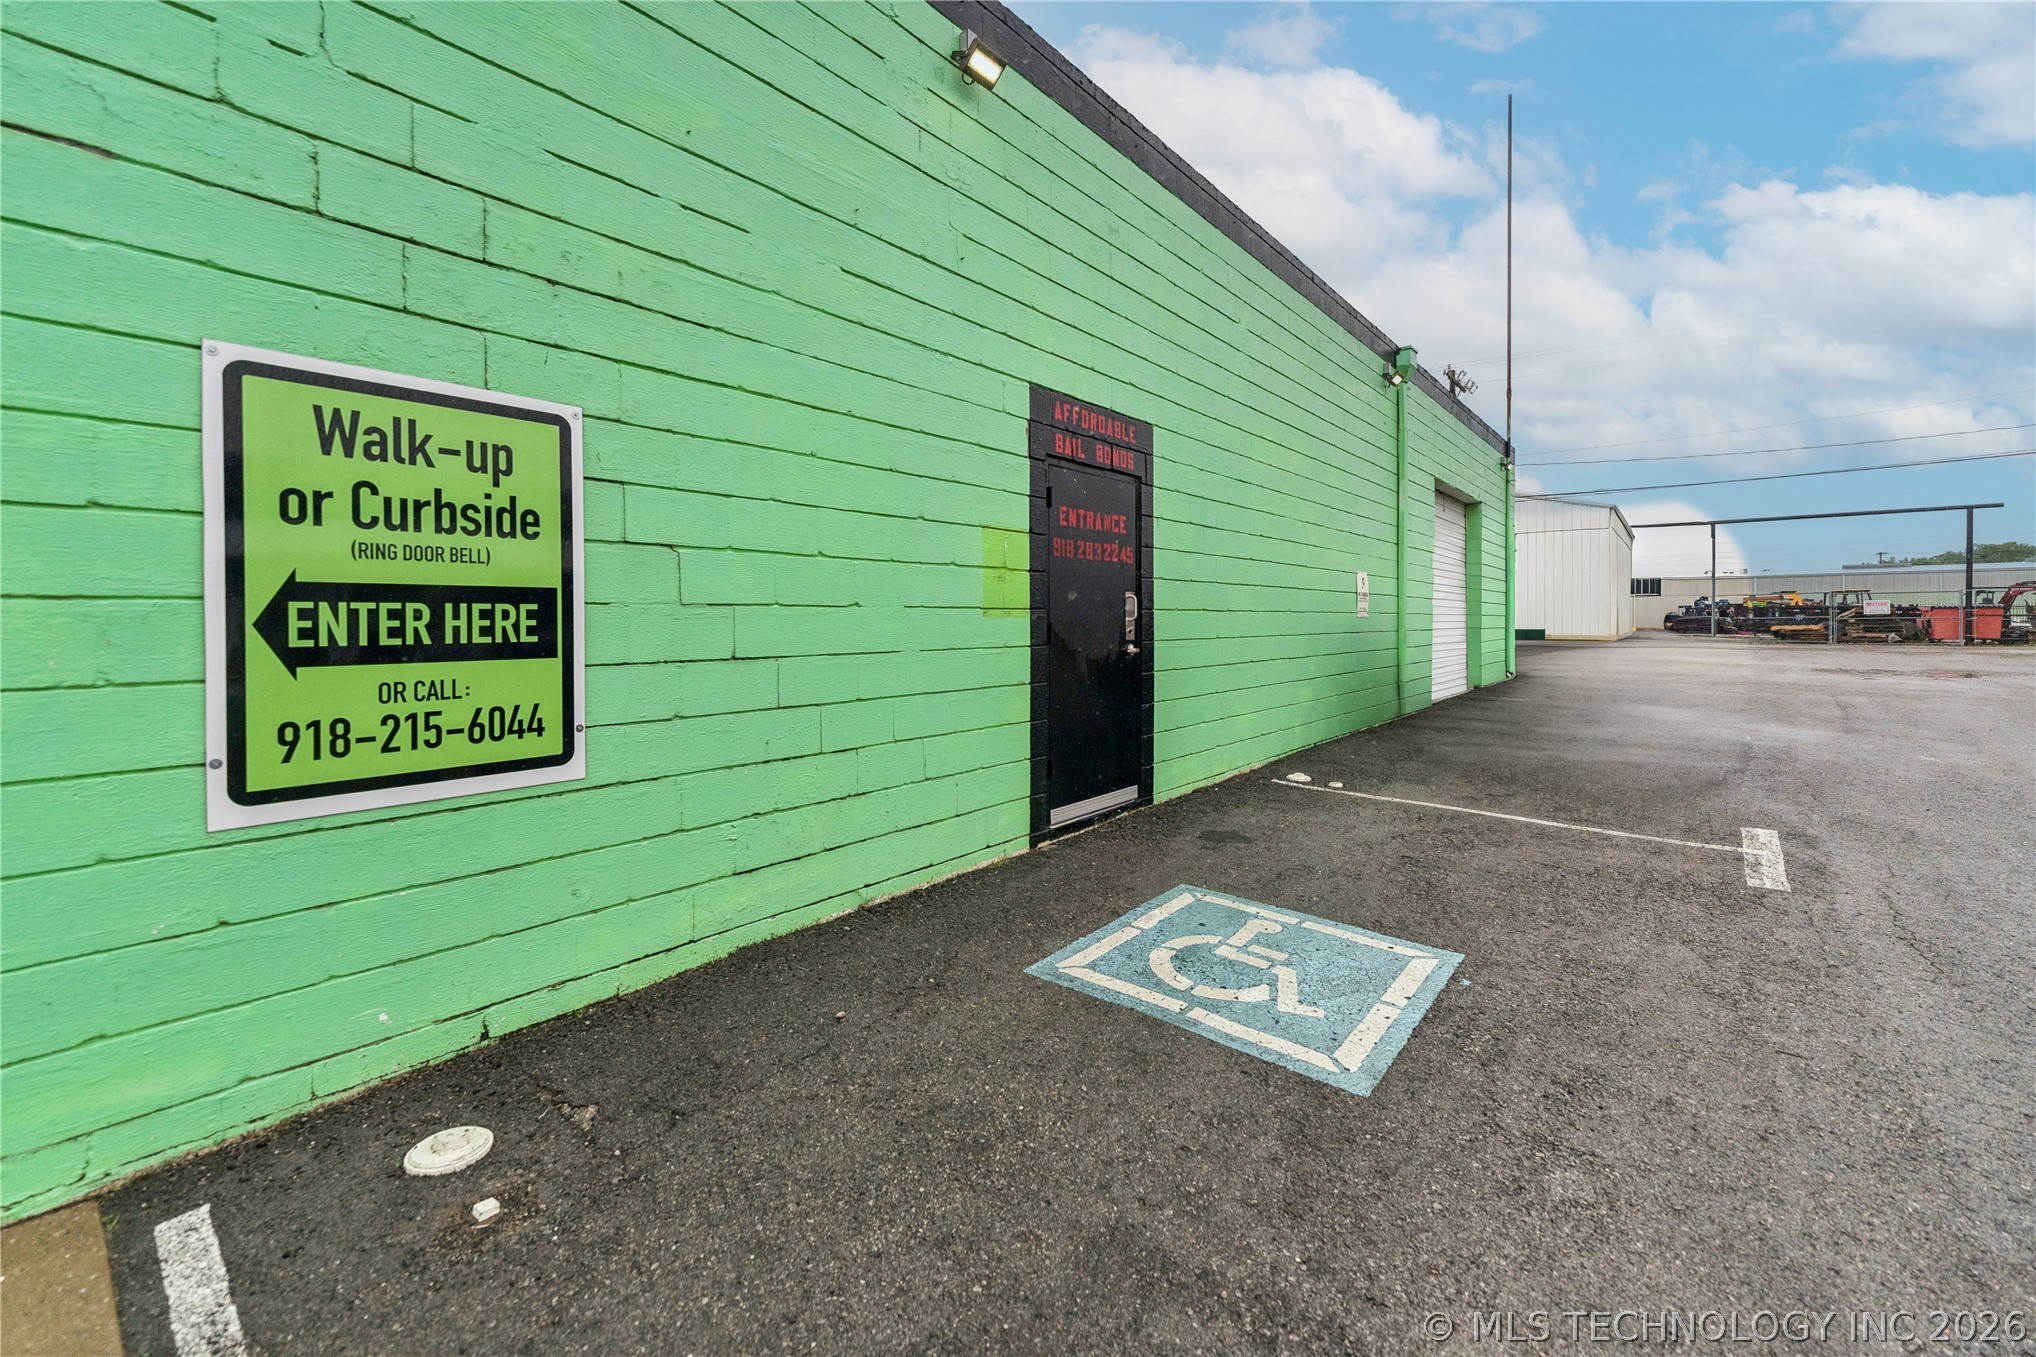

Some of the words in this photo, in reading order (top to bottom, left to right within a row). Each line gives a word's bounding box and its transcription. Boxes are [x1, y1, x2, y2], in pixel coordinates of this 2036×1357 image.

[1054, 400, 1136, 444] AFFORDABLE
[312, 404, 514, 488] Walk-up
[1055, 433, 1085, 459] BAIL
[1095, 444, 1134, 470] BONDS
[279, 487, 334, 527] or
[351, 480, 541, 540] Curbside
[1059, 505, 1127, 535] ENTRANCE
[351, 539, 398, 562] (RING
[402, 541, 445, 564] DOOR
[449, 546, 491, 567] BELL)
[288, 602, 432, 648] ENTER
[444, 603, 539, 645] HERE
[378, 681, 407, 704] OR
[413, 678, 470, 701] CALL:
[277, 703, 546, 764] 918-215-6044
